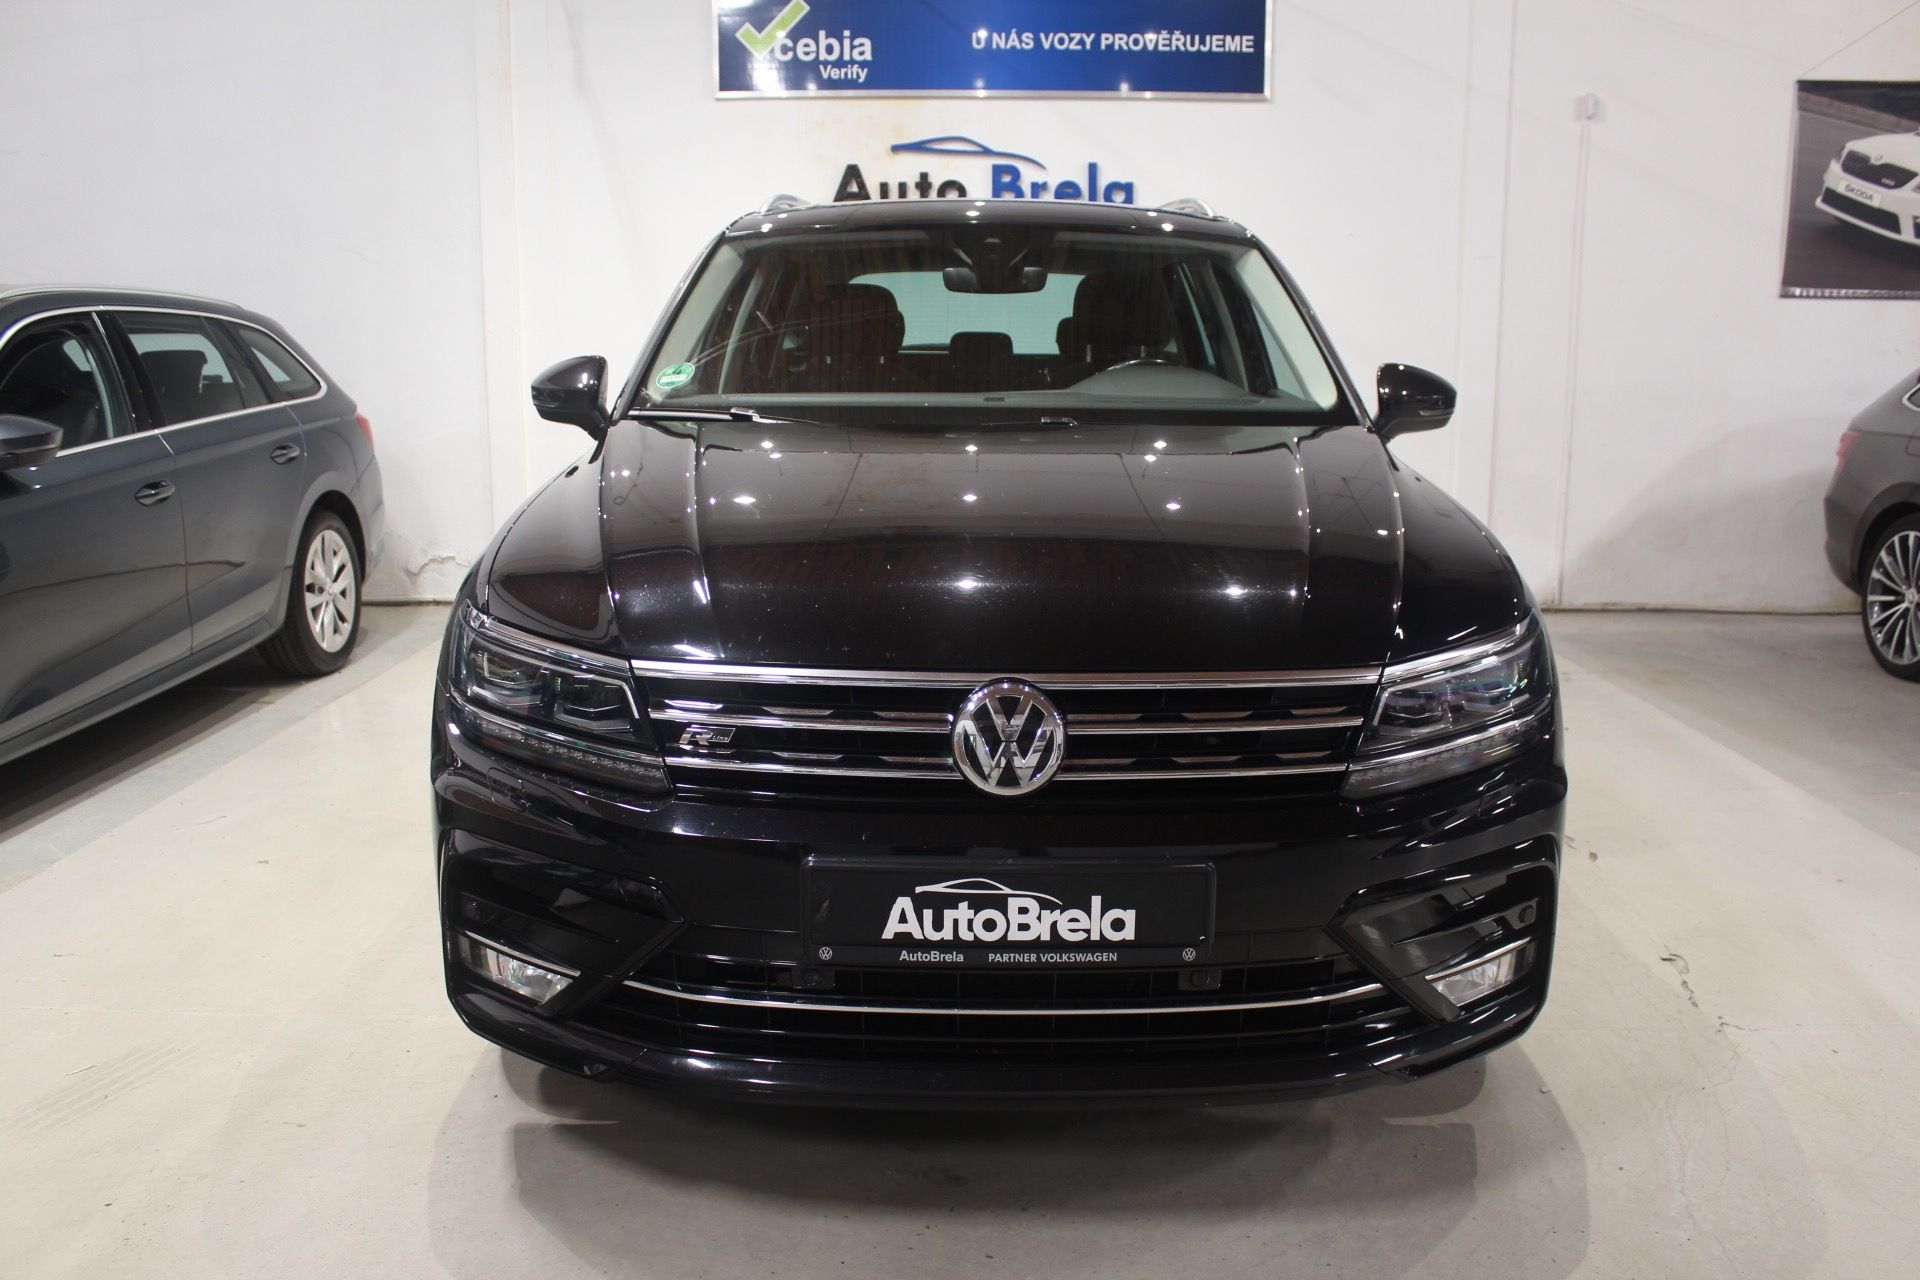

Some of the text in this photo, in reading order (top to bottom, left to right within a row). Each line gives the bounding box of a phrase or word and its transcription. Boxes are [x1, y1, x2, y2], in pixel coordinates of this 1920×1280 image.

[774, 30, 872, 61] cebia
[972, 29, 1255, 53] U NÁS VOZY PROVĚŘUJEME
[819, 64, 868, 83] Verify
[833, 162, 1134, 204] Auto Brela
[881, 895, 1136, 942] AutoBrela
[899, 950, 965, 963] AutoBrela
[988, 953, 1037, 963] PARTNER
[1040, 952, 1118, 963] VOLKSWAGEN
